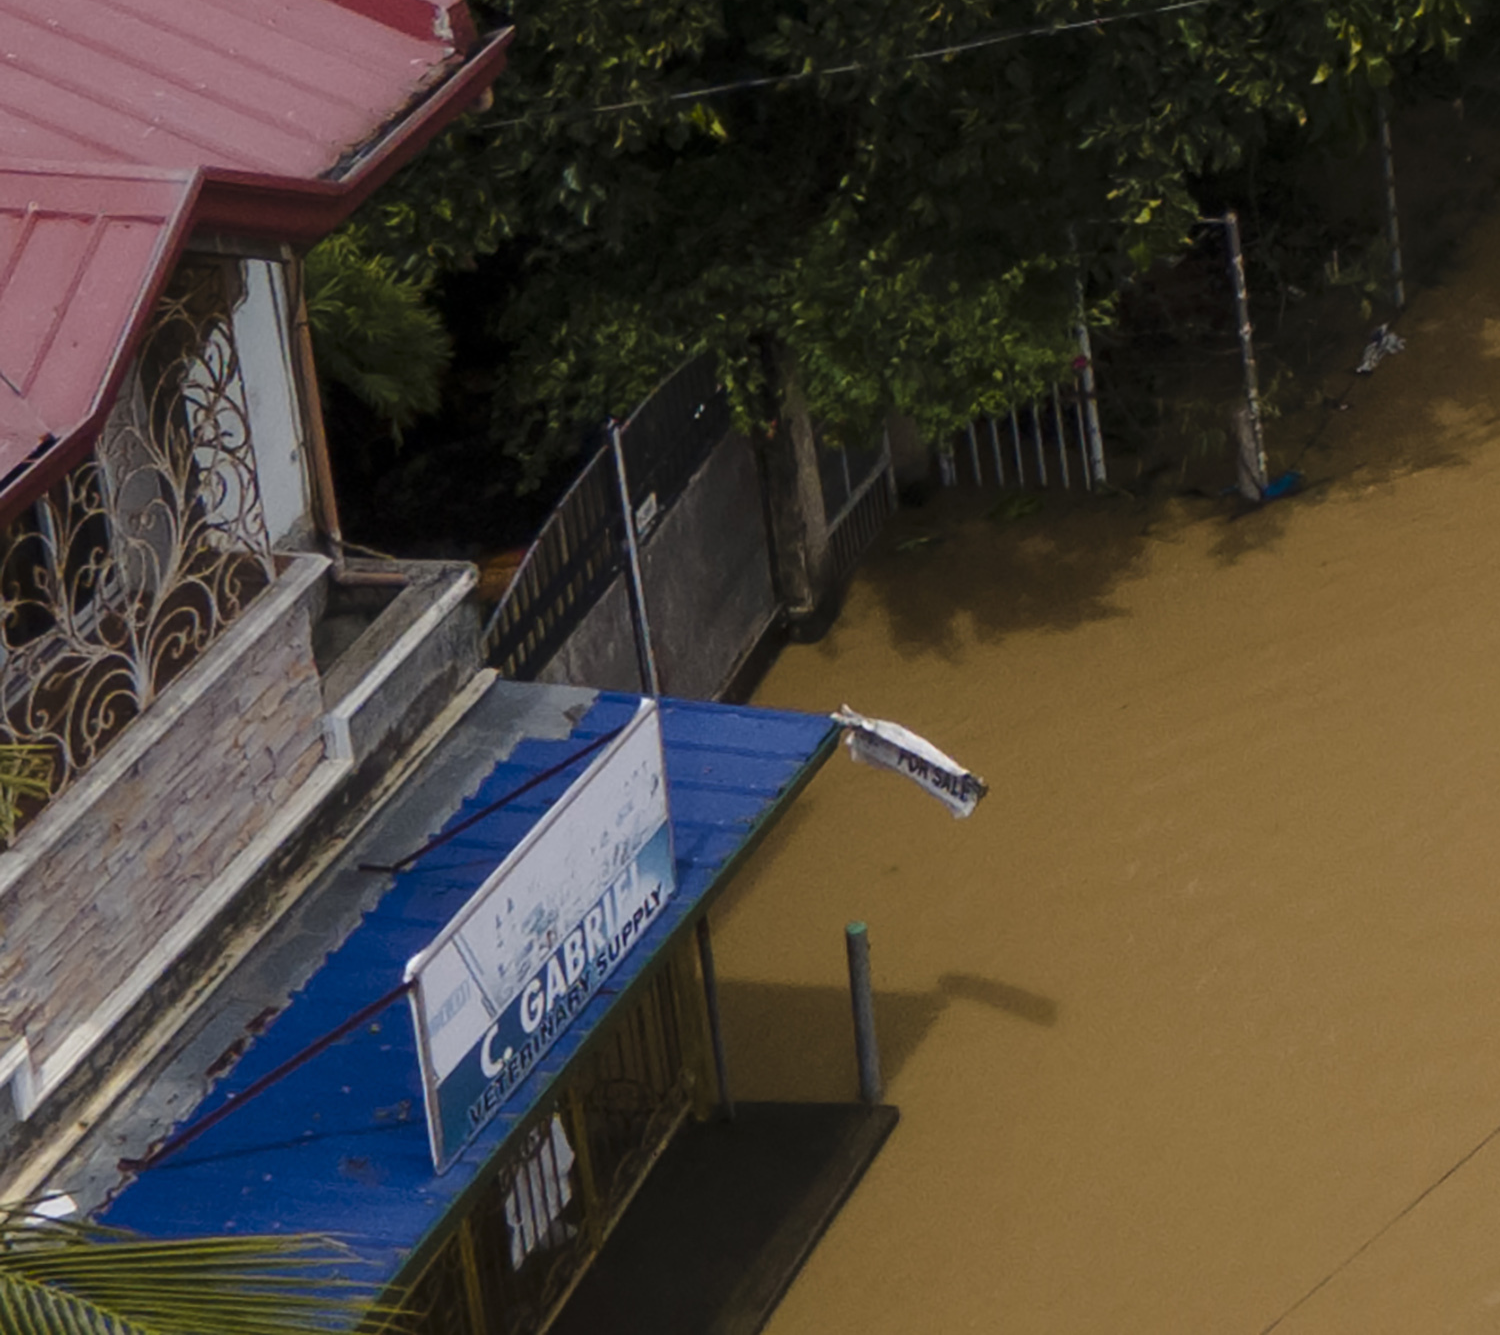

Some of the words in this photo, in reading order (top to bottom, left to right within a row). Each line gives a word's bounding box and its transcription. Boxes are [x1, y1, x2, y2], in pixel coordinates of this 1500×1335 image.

[468, 974, 594, 1128] VETERINARY
[595, 882, 663, 978] SUPPLY
[480, 1023, 513, 1078] C.
[519, 859, 642, 1034] GABRIEL
